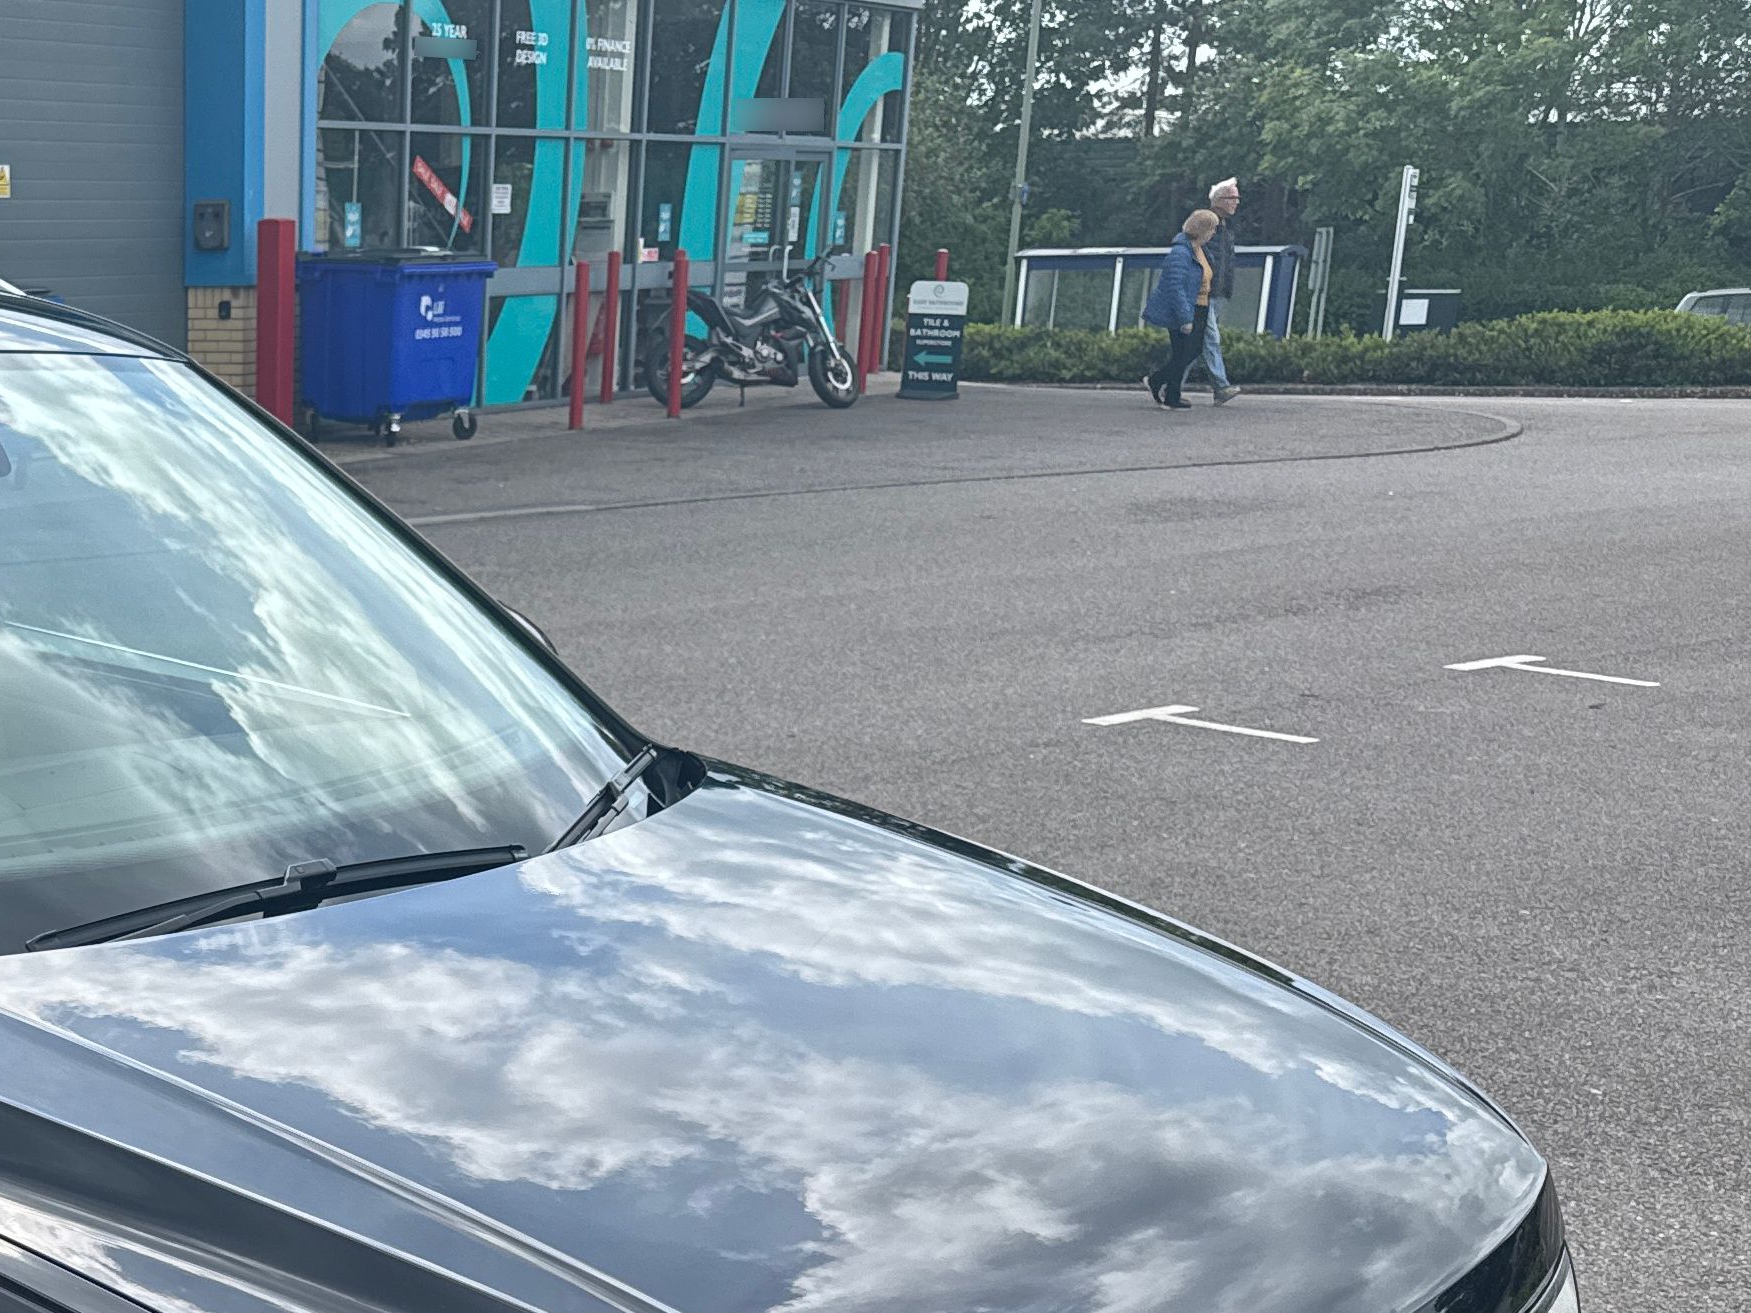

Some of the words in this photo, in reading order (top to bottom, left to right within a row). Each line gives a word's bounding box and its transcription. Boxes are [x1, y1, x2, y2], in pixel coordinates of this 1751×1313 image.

[444, 24, 468, 39] YEAR
[515, 31, 535, 45] FREE
[597, 38, 631, 53] FINANCE
[515, 49, 547, 65] DESIGN
[587, 56, 628, 71] AVAILABLE
[923, 318, 940, 327] TILE
[910, 328, 961, 338] BATHROOM
[908, 371, 929, 381] THIS
[931, 372, 954, 382] WAY
